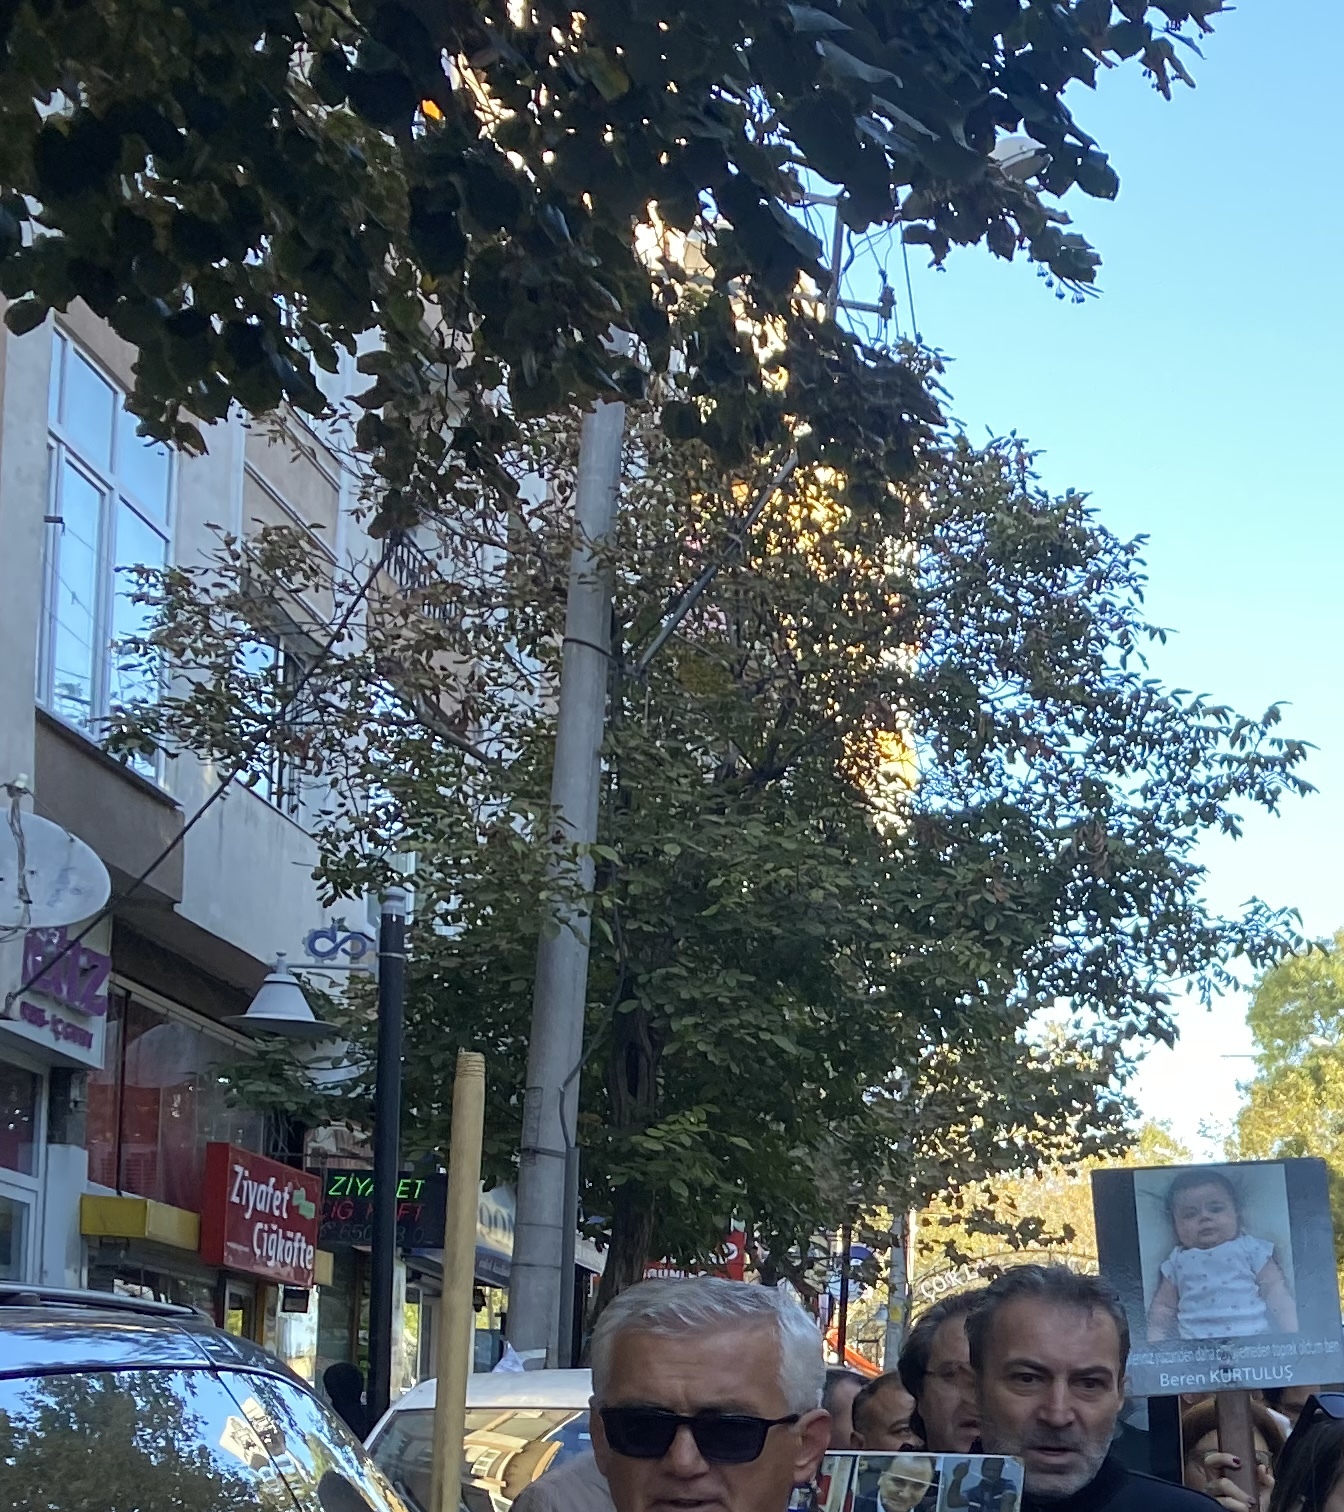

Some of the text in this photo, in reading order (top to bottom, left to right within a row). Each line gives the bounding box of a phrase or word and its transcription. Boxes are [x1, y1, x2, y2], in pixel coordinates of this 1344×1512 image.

[230, 1164, 291, 1220] Ziyafet
[328, 1173, 427, 1199] ZİYET
[253, 1222, 314, 1270] Çiğköfte
[1160, 1364, 1295, 1388] Beren KURTULUŞ
